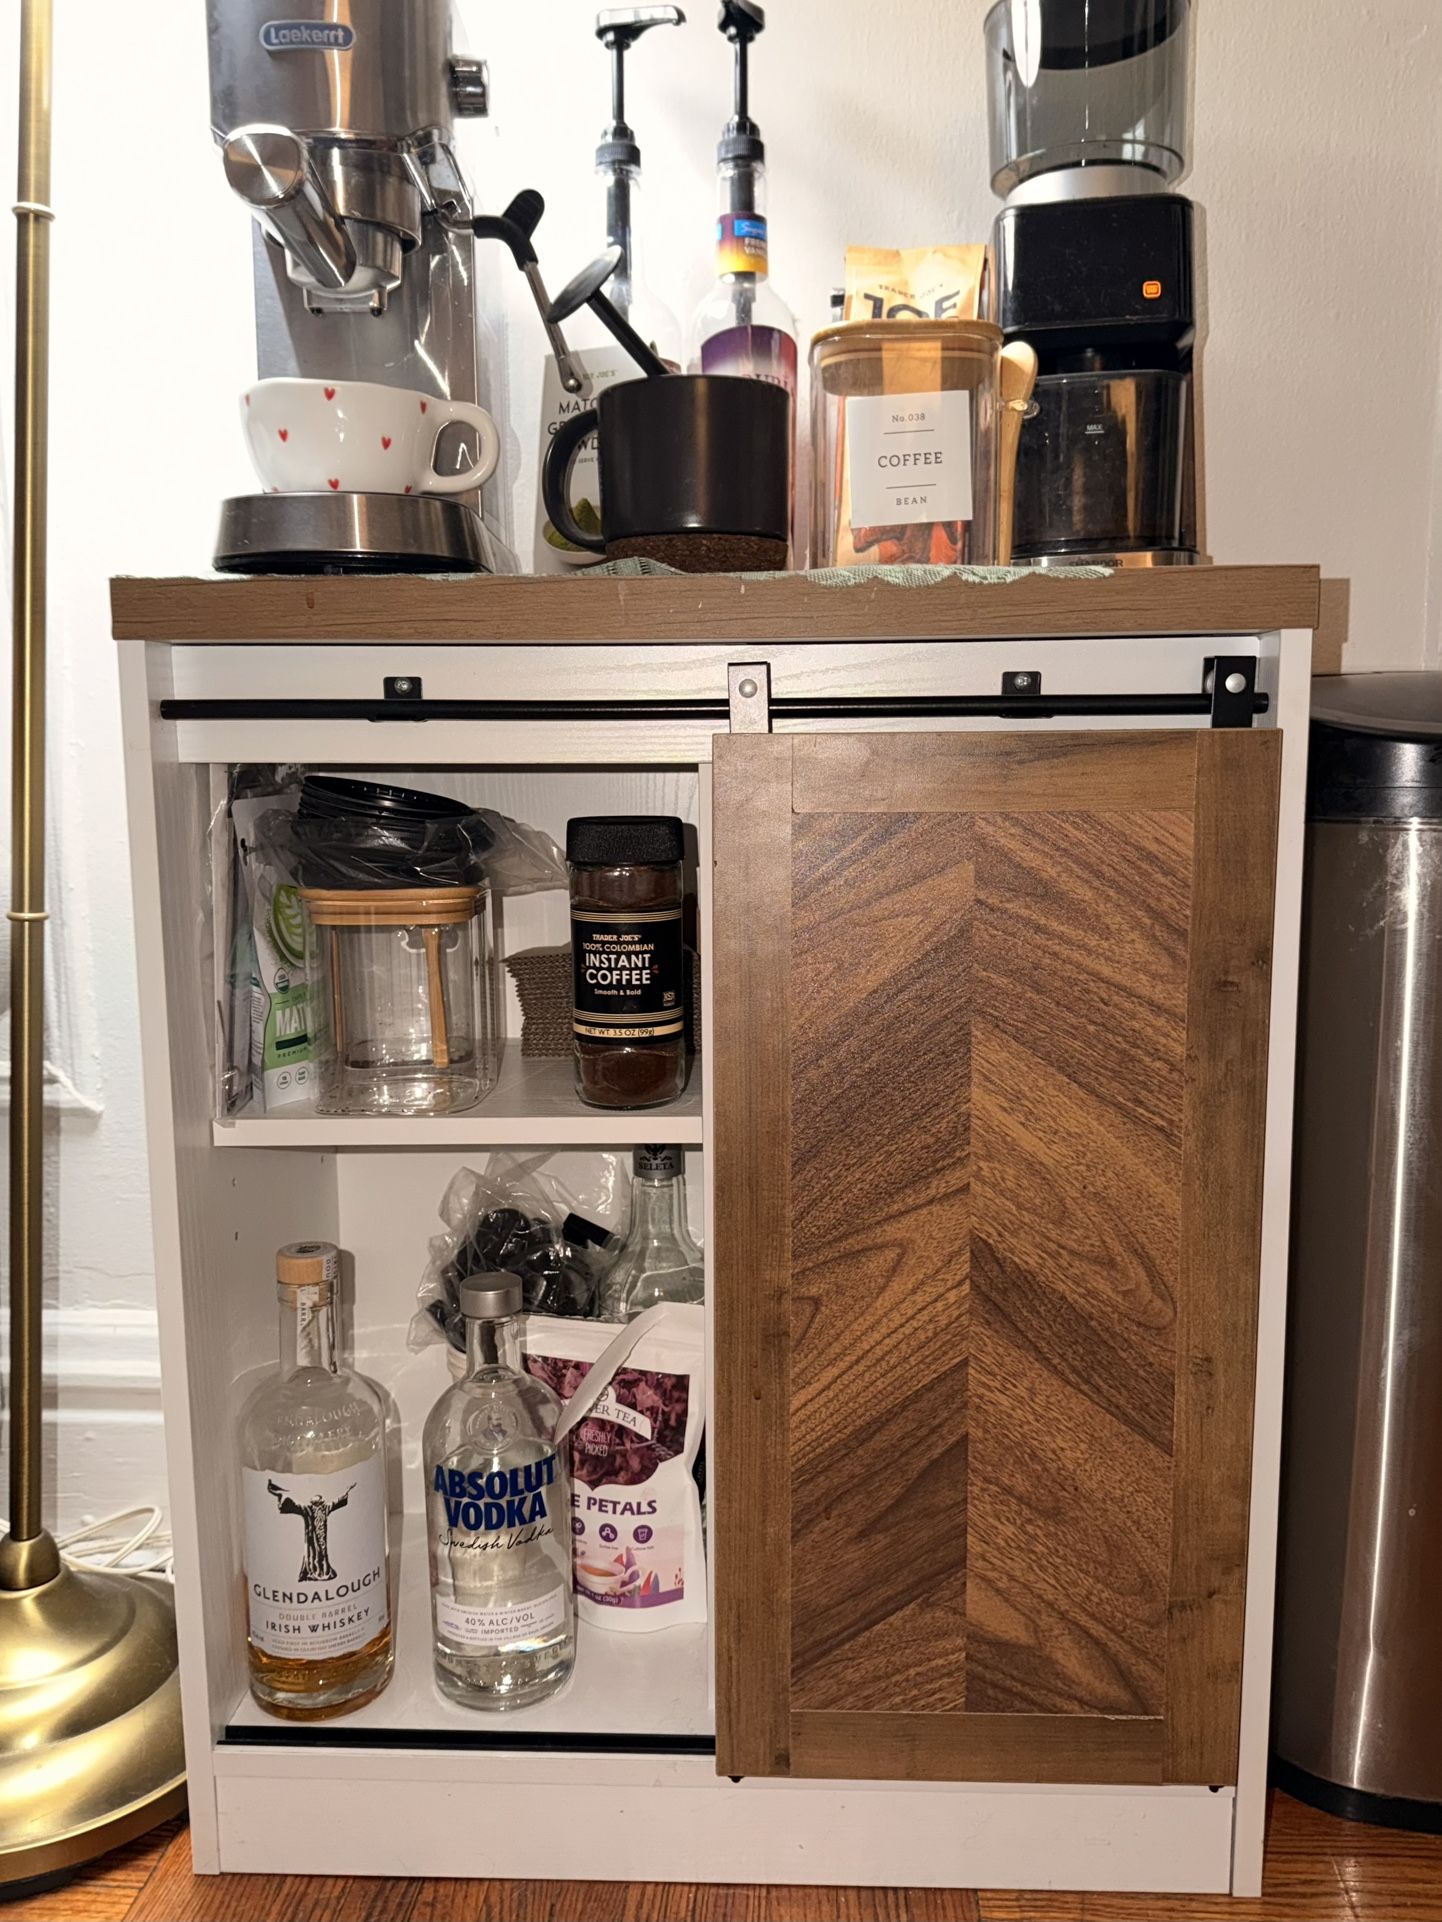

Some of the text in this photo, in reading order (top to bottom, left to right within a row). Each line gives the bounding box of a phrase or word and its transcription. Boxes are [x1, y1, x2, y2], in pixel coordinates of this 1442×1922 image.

[269, 25, 345, 44] Laekerrt
[877, 451, 943, 468] COFFEE
[895, 496, 928, 506] BEAN
[592, 934, 618, 942] TRADER
[582, 942, 655, 952] 100% COLOMBIAN
[585, 953, 651, 968] INSTANT
[585, 969, 651, 985] COFFEE
[594, 988, 618, 996] Smooth
[584, 1027, 597, 1035] NET
[612, 1029, 623, 1037] 3.5
[638, 1161, 674, 1171] SELETA
[614, 1407, 638, 1427] TEA
[583, 1429, 613, 1444] FRESHLY
[584, 1441, 609, 1457] PICKED
[434, 1452, 557, 1500] ABSOLUT
[443, 1491, 548, 1531] VODKA
[586, 1496, 657, 1516] PETALS
[439, 1524, 554, 1551] Swedish Vodka
[253, 1566, 380, 1604] GLENDALOUGH
[265, 1606, 370, 1635] IRISH WHISKEY
[278, 1603, 358, 1622] DOUBLE BARREL
[464, 1616, 486, 1627] 40%
[489, 1612, 535, 1627] ALC/VOL
[481, 1626, 519, 1635] IMPORTED
